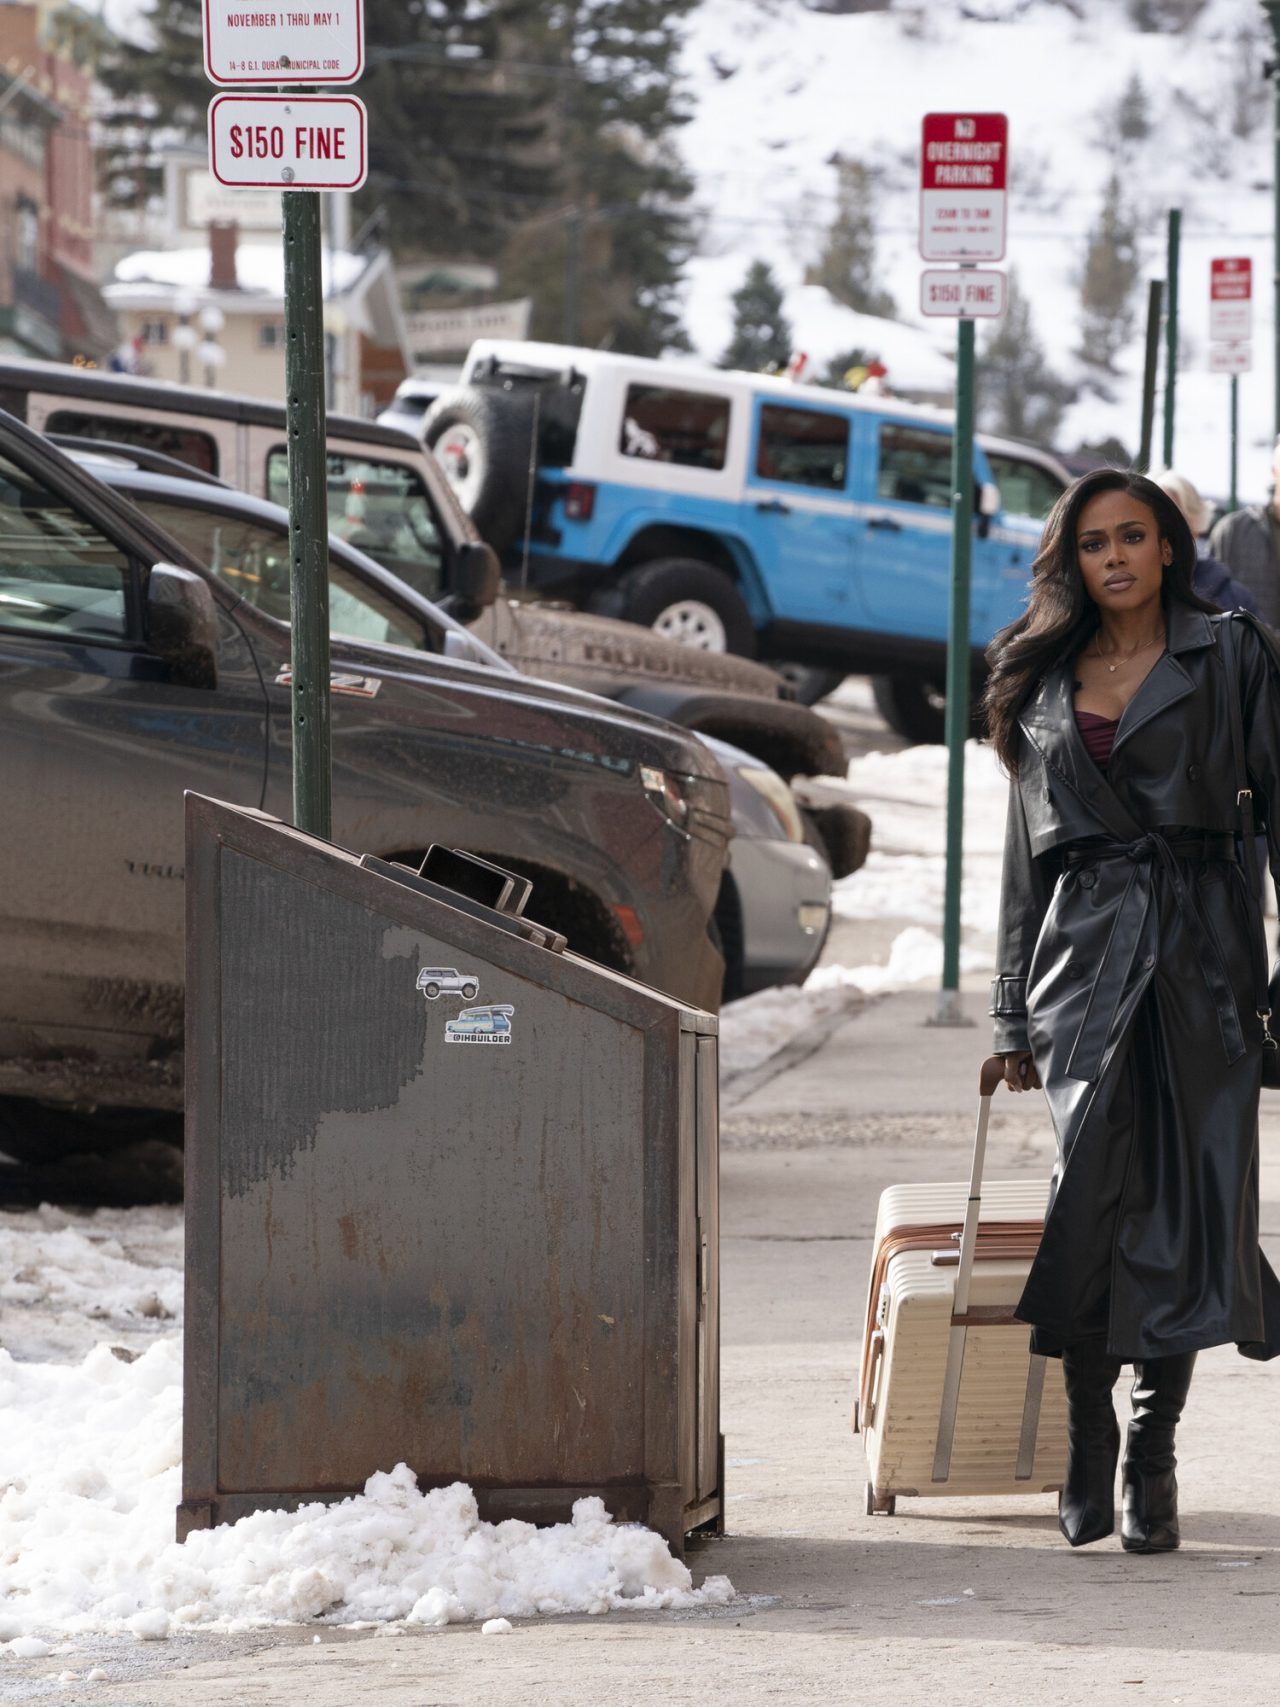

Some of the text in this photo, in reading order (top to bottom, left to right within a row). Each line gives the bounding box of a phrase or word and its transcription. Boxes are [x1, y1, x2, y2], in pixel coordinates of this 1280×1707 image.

[227, 13, 340, 27] NOVEMBER 1 THRU MAY 1
[323, 60, 340, 70] CODE
[954, 118, 976, 139] NO
[229, 124, 346, 160] $150 FINE
[926, 141, 1002, 162] OVERNIGHT
[935, 164, 994, 185] PARKING
[929, 284, 995, 303] $150 FINE
